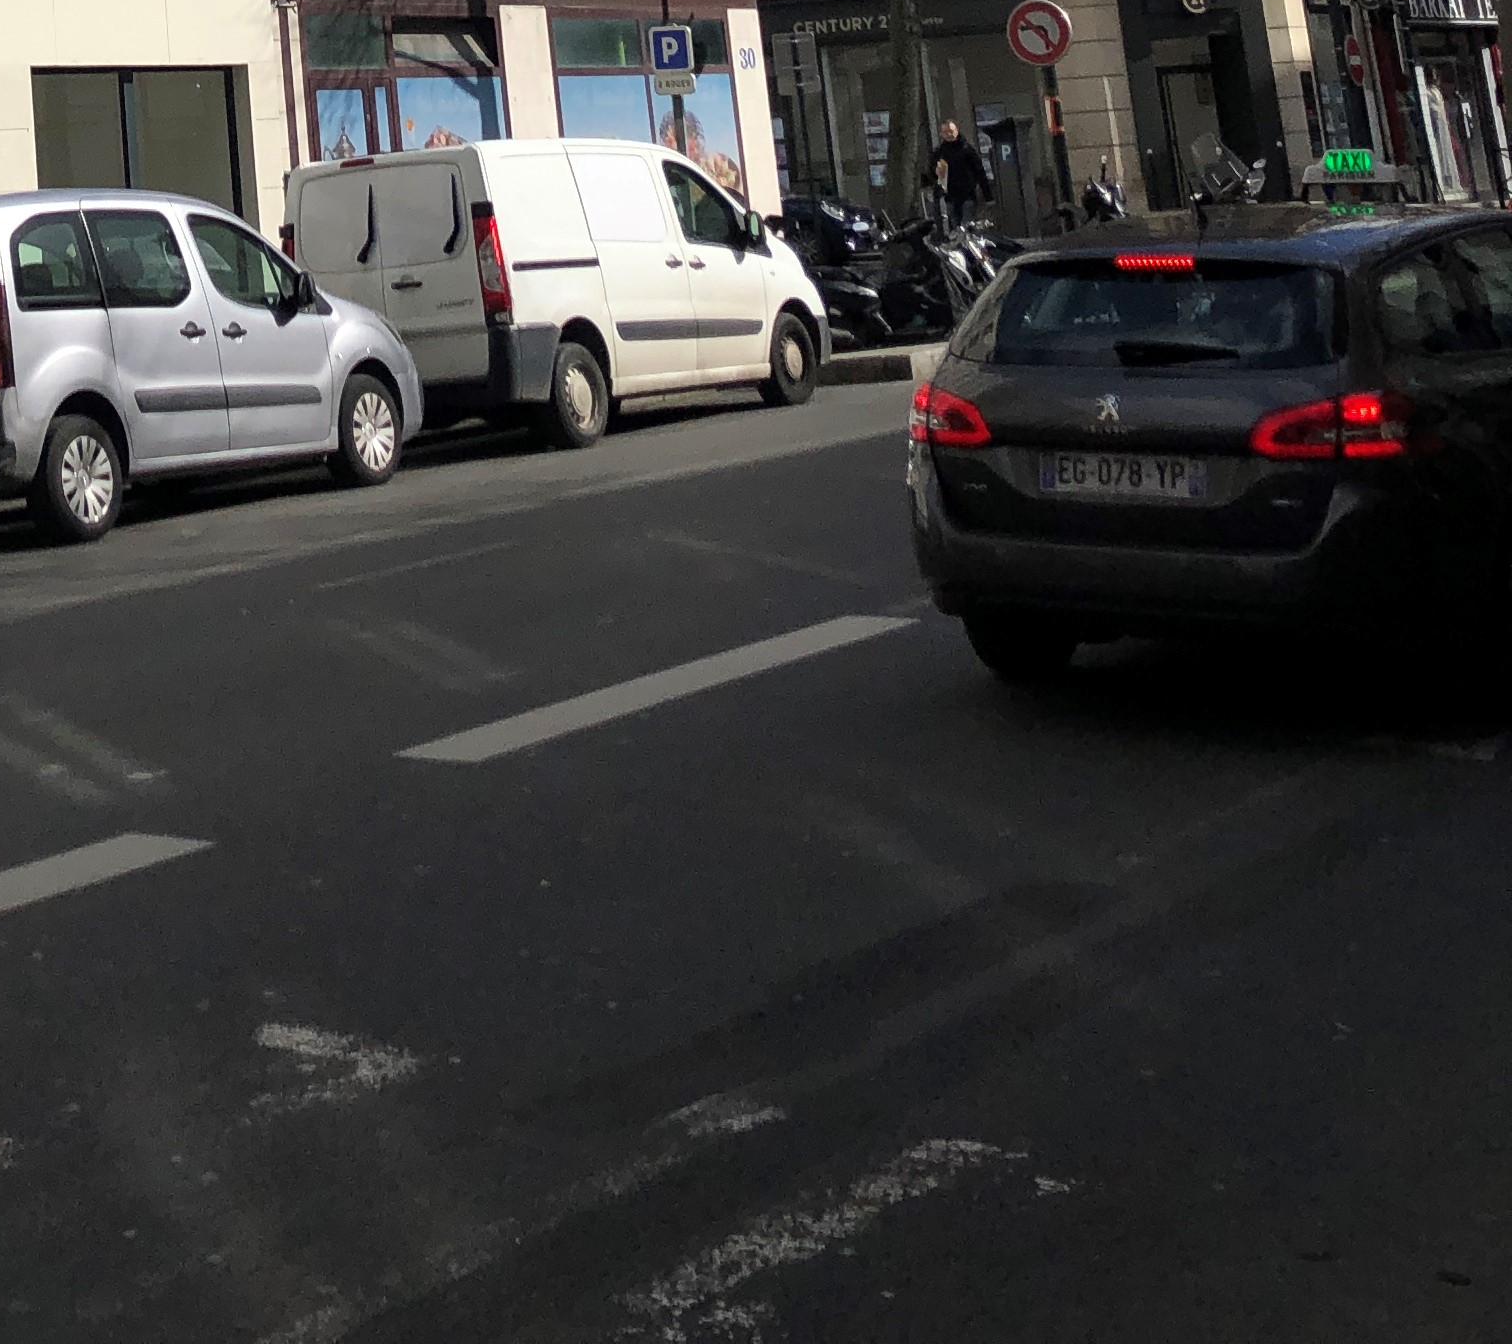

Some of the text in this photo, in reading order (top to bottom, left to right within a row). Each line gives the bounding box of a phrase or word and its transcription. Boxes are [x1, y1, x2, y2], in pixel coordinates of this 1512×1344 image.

[793, 16, 874, 35] CENTURY
[661, 37, 679, 64] P
[739, 47, 756, 70] 30
[1329, 152, 1367, 170] TAXI
[1057, 457, 1186, 489] EG-078-YP
